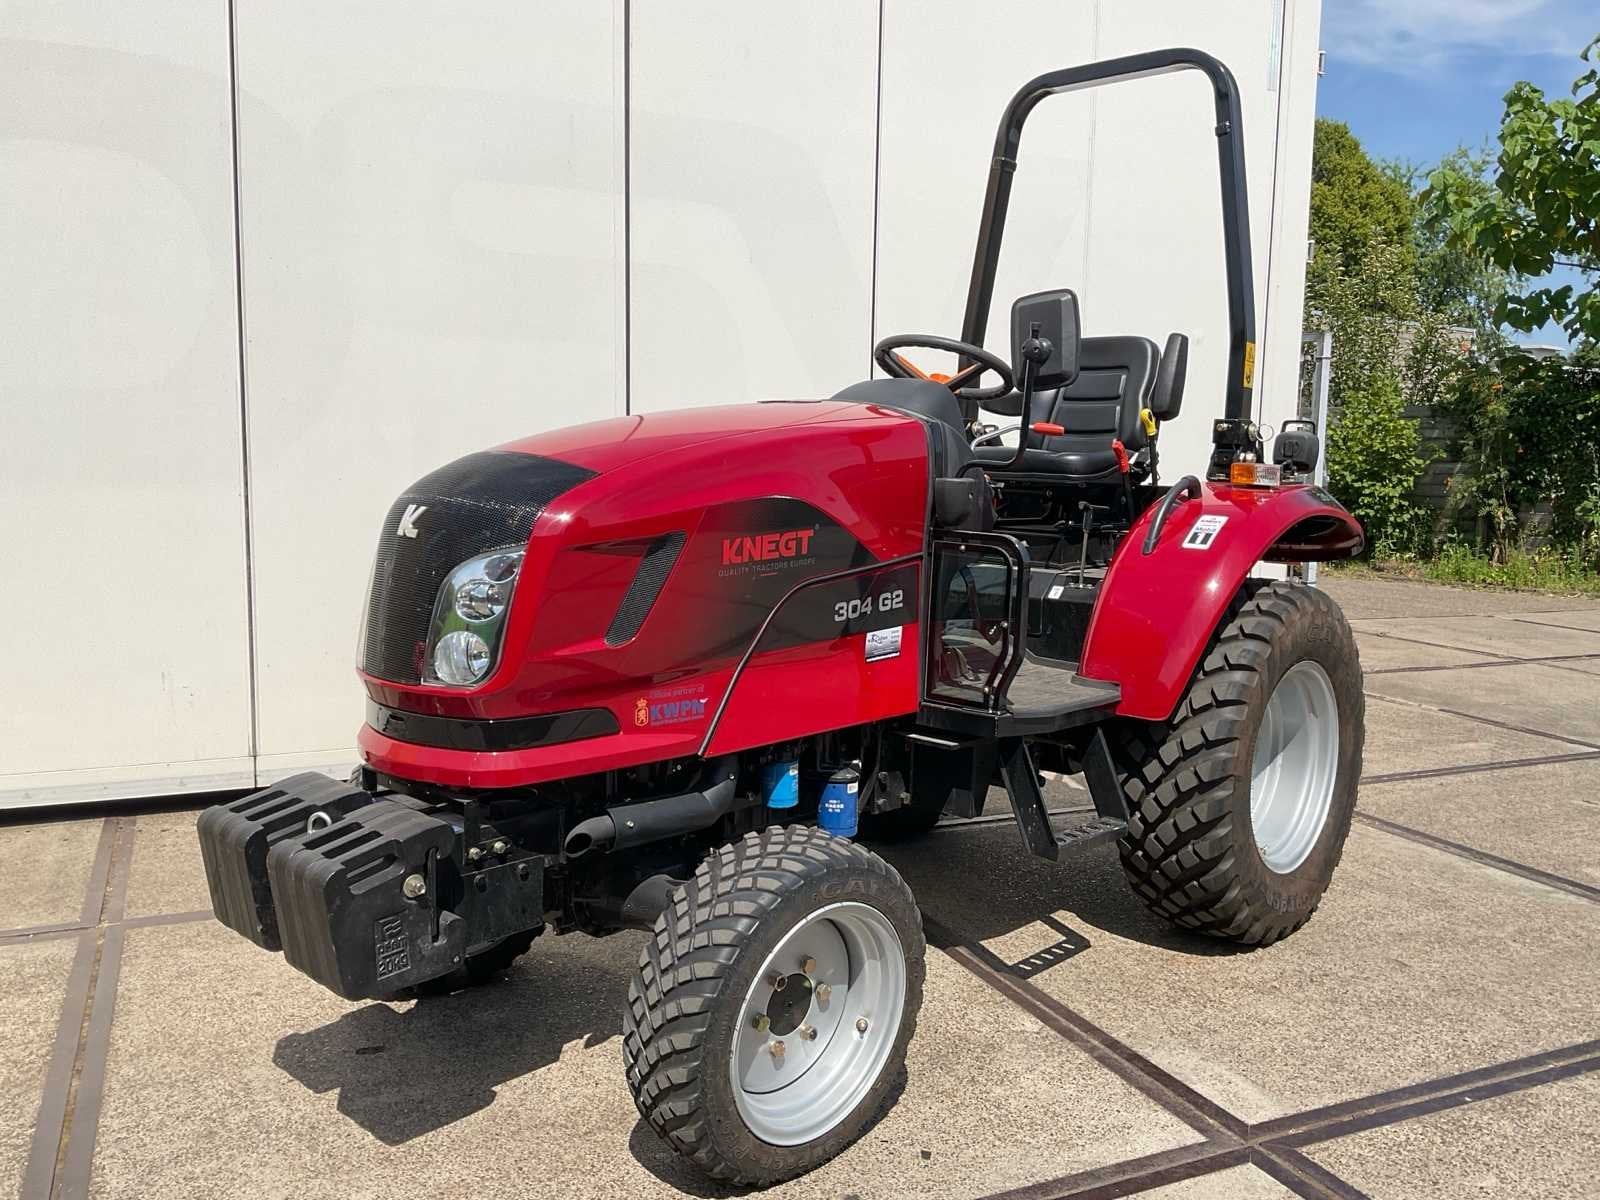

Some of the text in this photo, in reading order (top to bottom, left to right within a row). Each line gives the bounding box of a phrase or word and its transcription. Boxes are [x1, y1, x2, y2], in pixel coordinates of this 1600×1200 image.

[397, 504, 427, 538] K
[722, 529, 814, 565] KNEGT
[718, 567, 749, 577] QUALITY
[752, 561, 788, 572] TRACTORS
[834, 589, 904, 622] 304 G2
[650, 699, 705, 720] KWPN
[379, 952, 409, 978] 20KG
